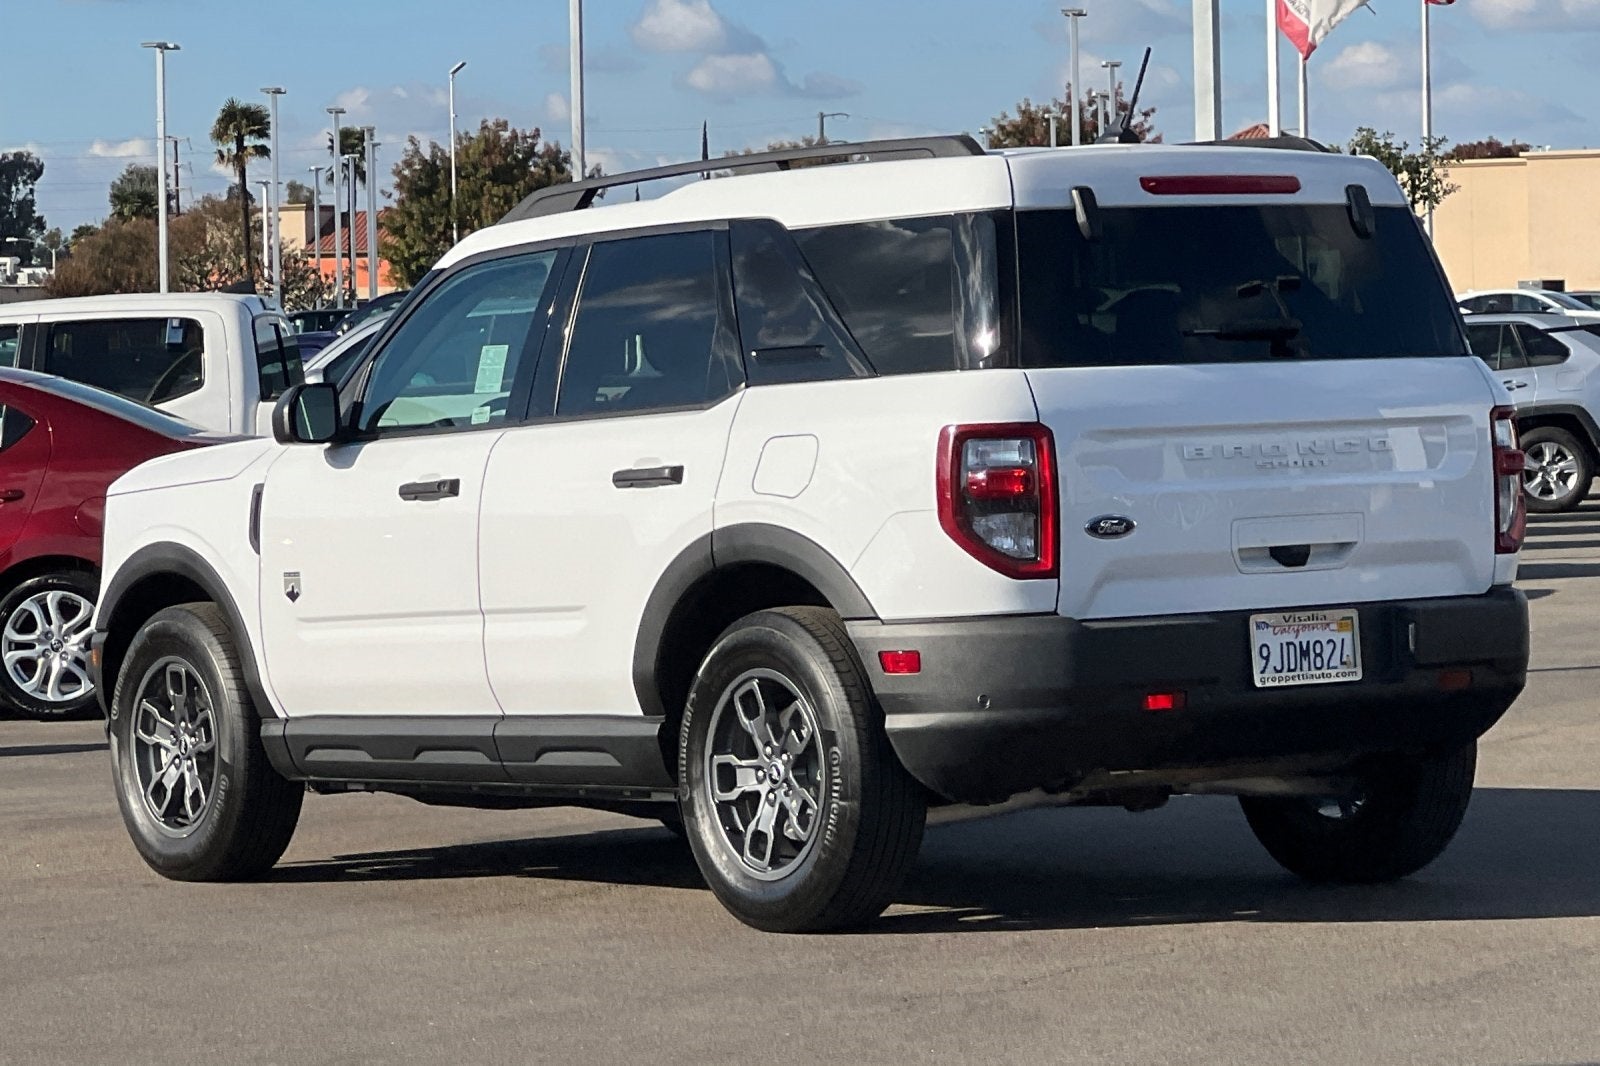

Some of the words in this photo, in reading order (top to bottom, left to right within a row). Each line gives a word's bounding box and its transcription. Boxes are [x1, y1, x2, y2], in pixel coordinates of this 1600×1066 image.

[1183, 437, 1392, 460] BRONCO
[1255, 456, 1331, 470] SPORT
[1098, 519, 1127, 534] Ford
[1282, 613, 1327, 623] Visalia
[1259, 669, 1358, 686] groppettiauto.com
